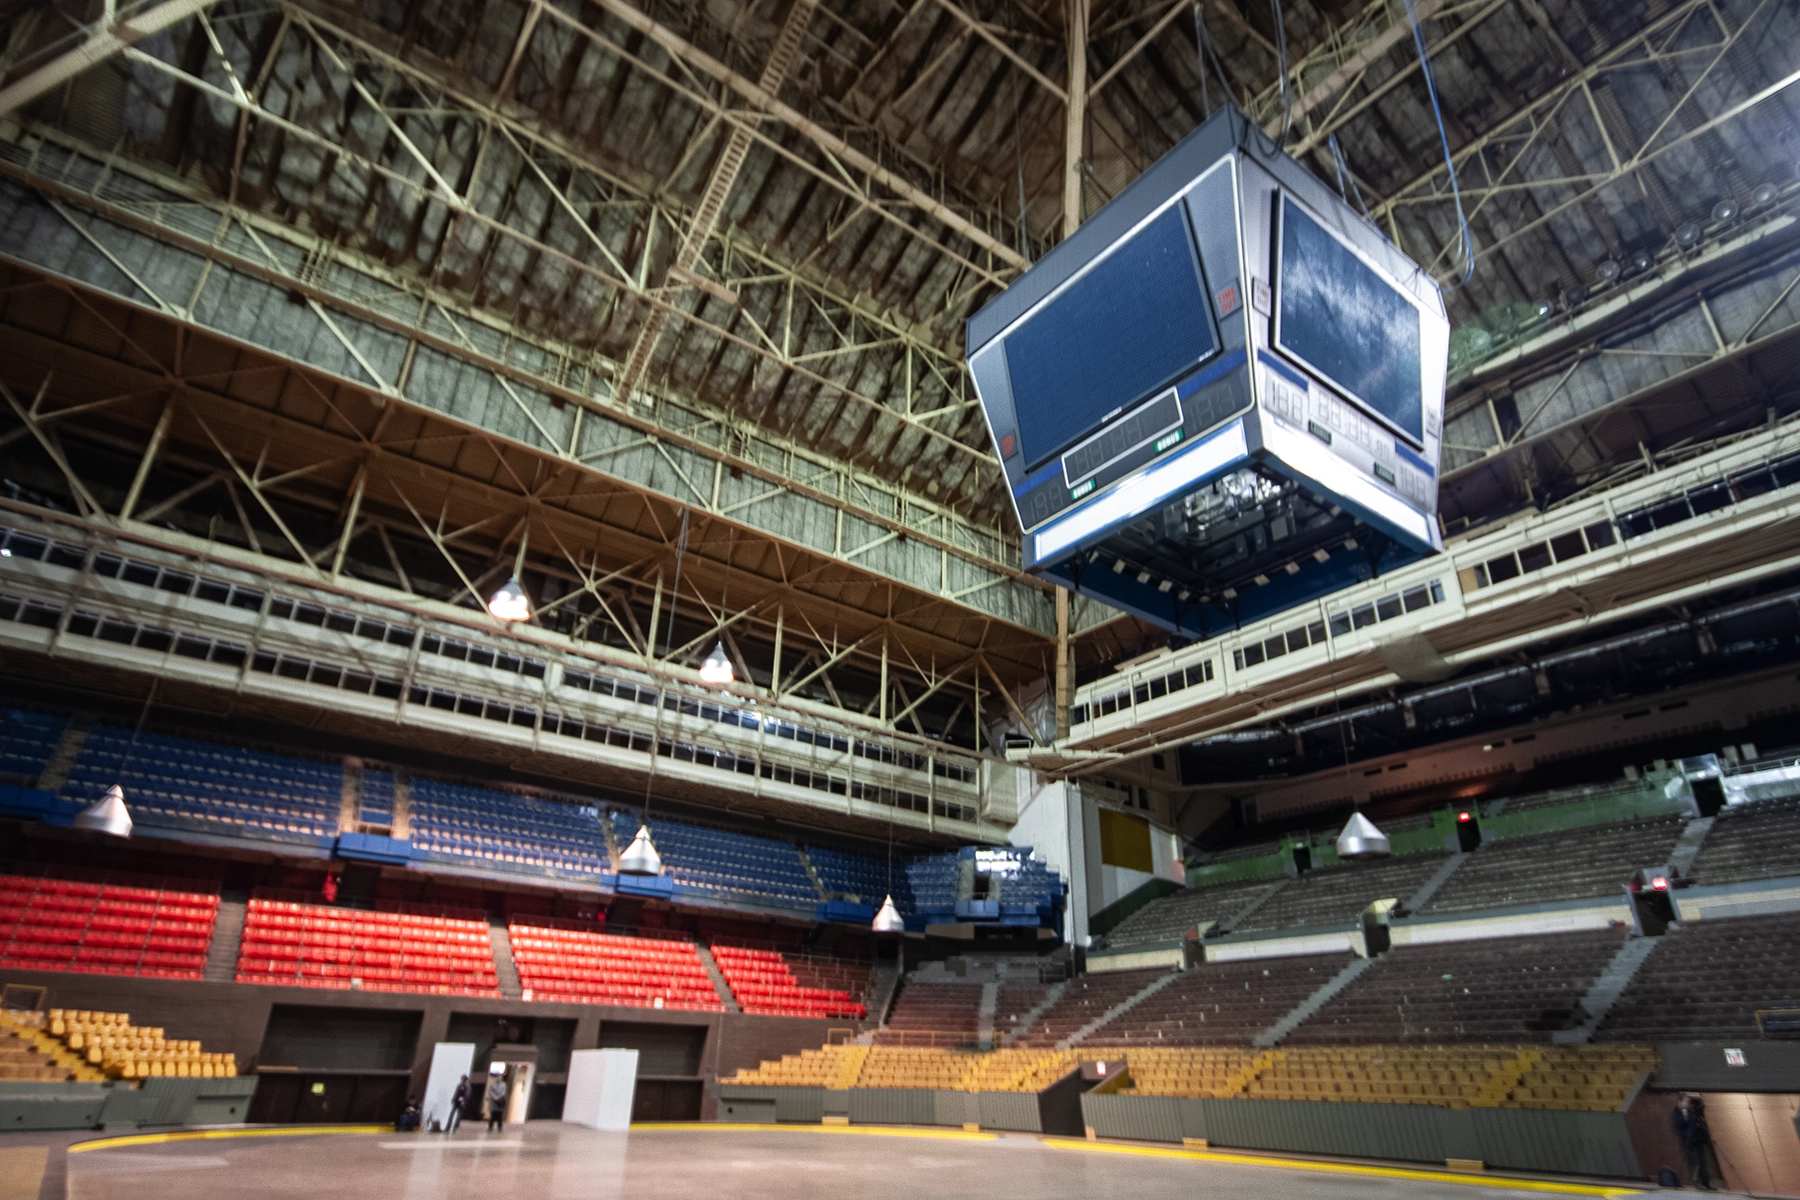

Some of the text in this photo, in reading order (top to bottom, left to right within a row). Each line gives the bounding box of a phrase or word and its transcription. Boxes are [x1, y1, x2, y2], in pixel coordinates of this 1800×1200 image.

[1217, 286, 1234, 302] TIME
[1221, 296, 1236, 312] OUT
[1157, 430, 1180, 452] BONUS
[1073, 480, 1092, 499] BONUS
